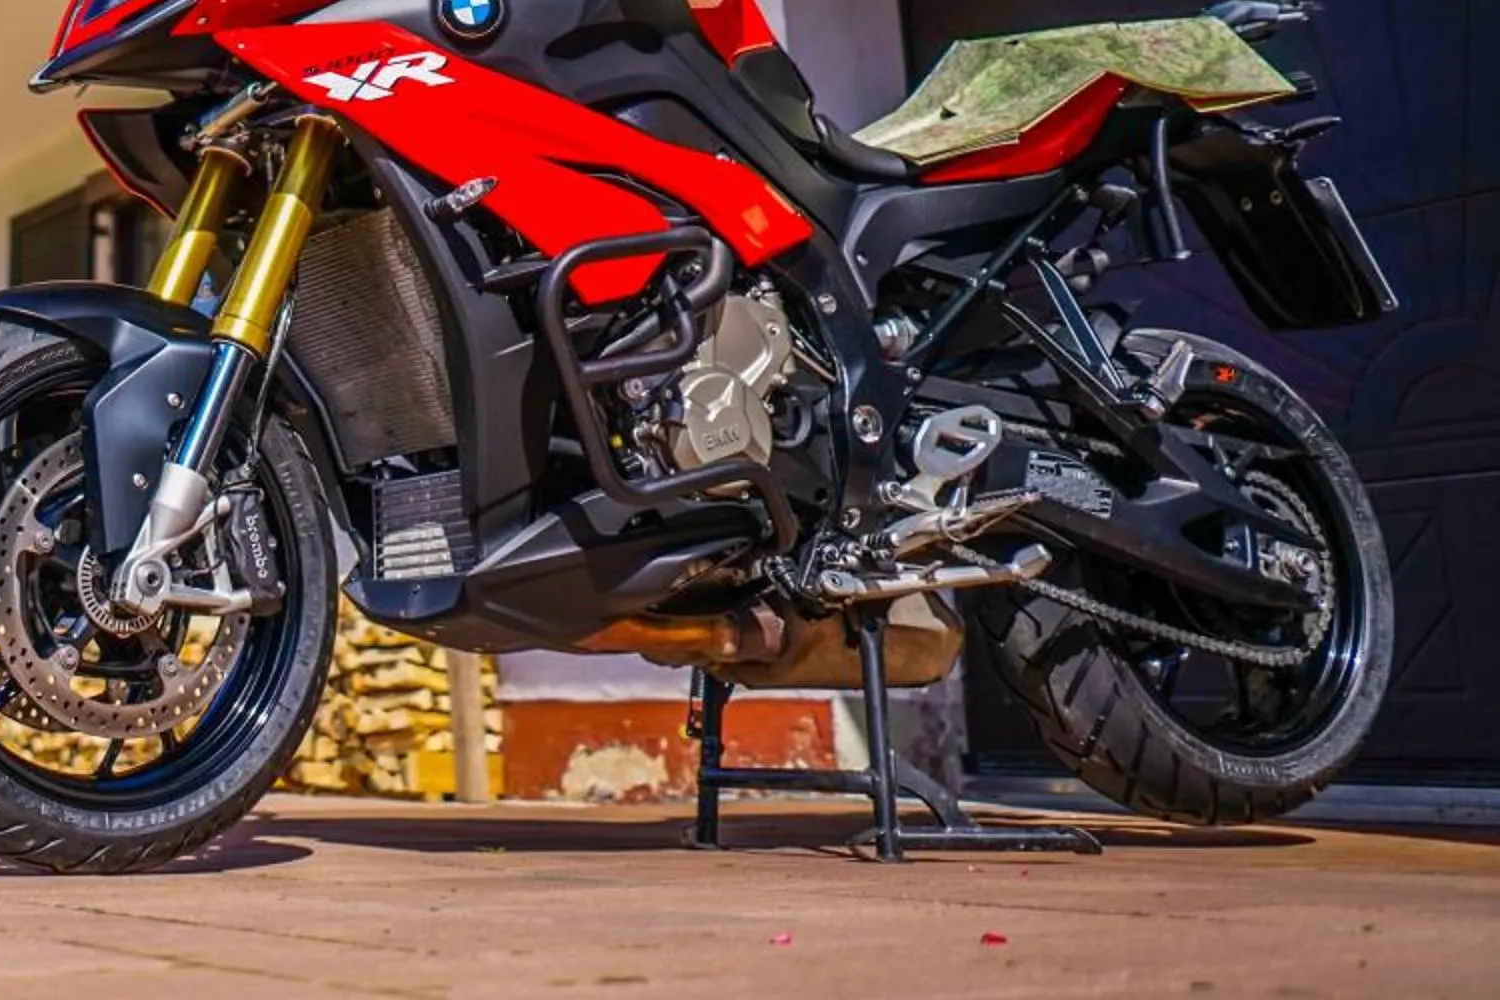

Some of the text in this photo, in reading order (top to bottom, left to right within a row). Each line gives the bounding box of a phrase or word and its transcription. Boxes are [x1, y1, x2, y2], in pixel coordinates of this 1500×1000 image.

[302, 51, 456, 102] XR
[704, 424, 740, 451] BMW
[245, 514, 268, 579] brembo
